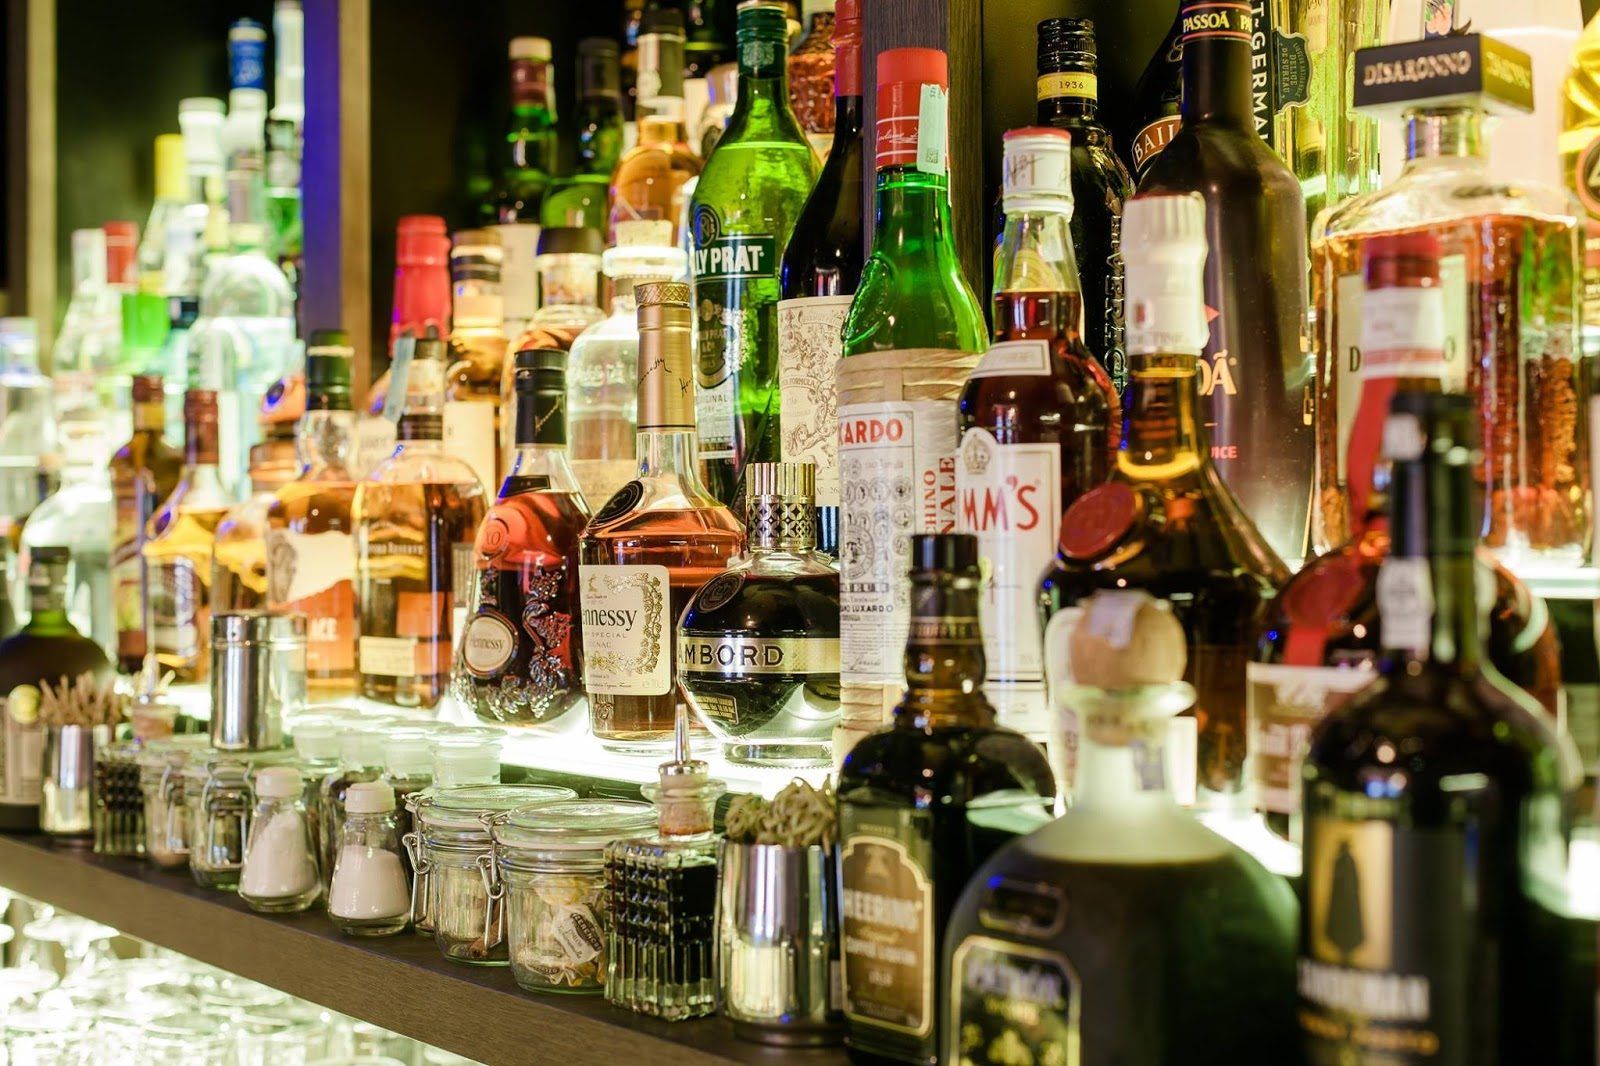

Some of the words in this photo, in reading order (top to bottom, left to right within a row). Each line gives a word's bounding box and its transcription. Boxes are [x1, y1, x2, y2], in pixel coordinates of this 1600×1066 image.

[1059, 81, 1084, 90] 1936
[710, 245, 763, 274] PRAT
[852, 604, 894, 613] LUXARDO
